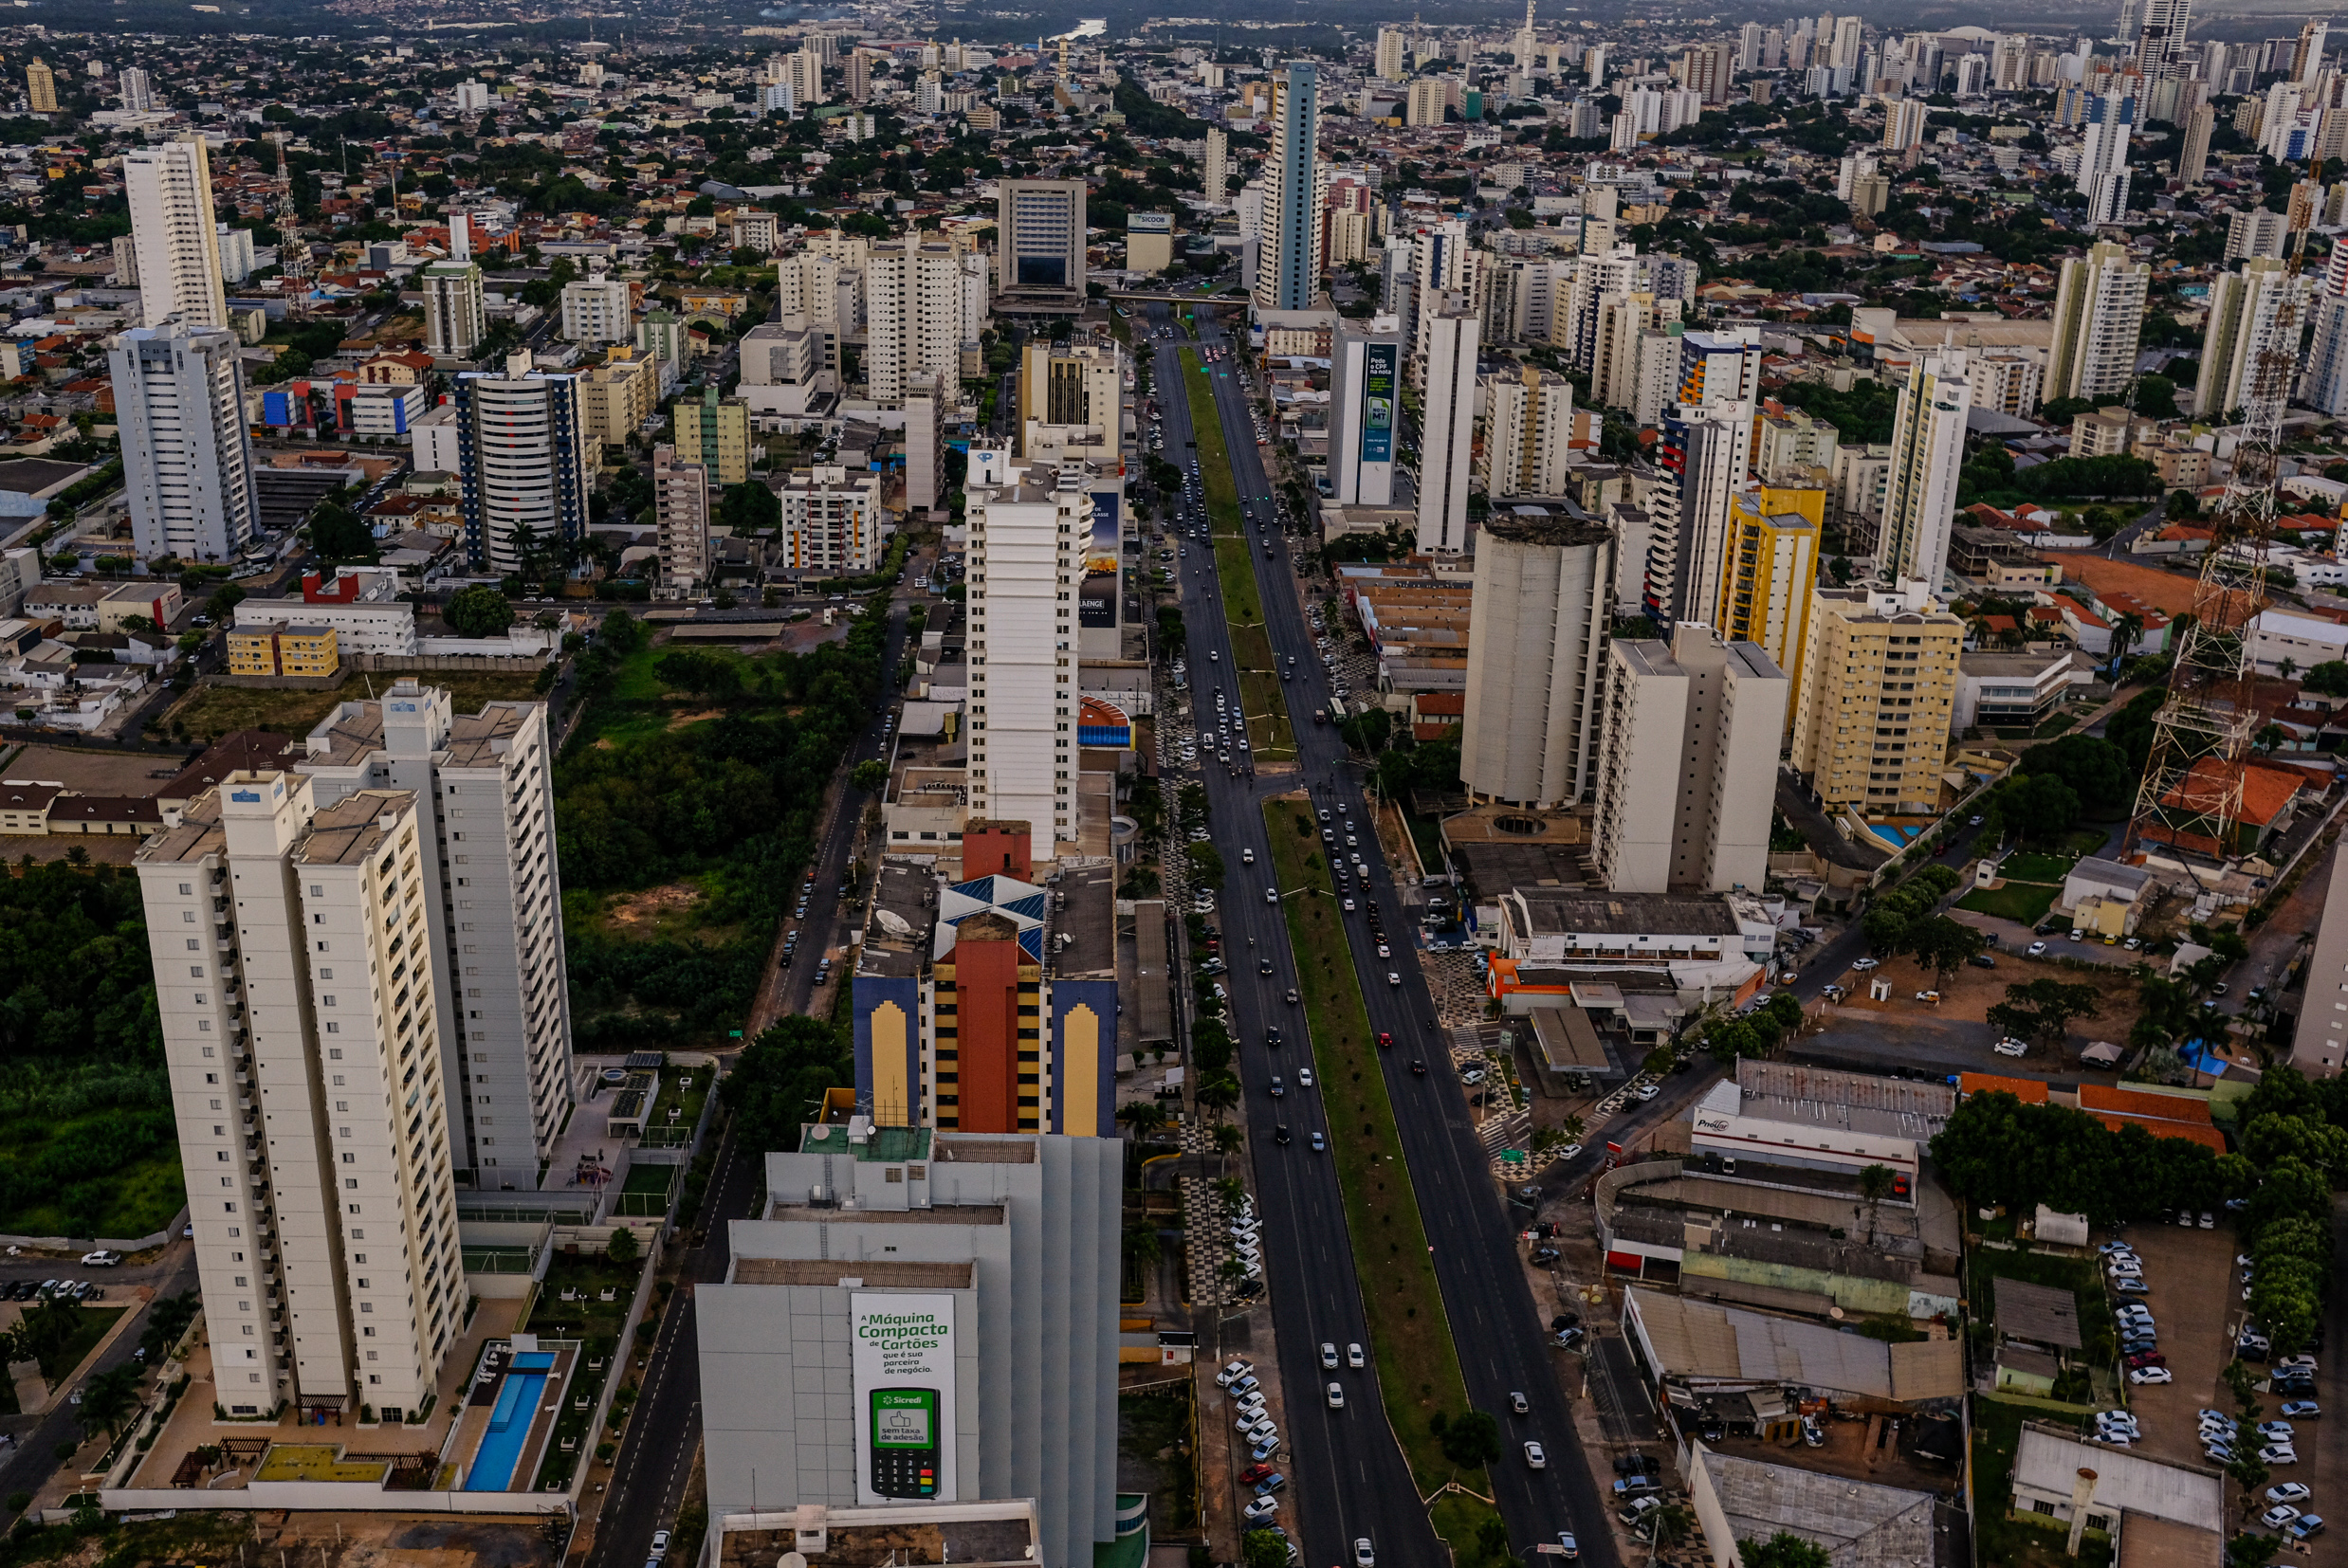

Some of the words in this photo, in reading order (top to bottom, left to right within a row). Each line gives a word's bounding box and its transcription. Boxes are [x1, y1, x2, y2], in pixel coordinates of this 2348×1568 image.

[869, 1312, 934, 1326] Máquina
[858, 1323, 948, 1340] Compacta
[881, 1338, 939, 1351] Cartões
[883, 1358, 920, 1367] parceira
[896, 1365, 932, 1375] negócio.
